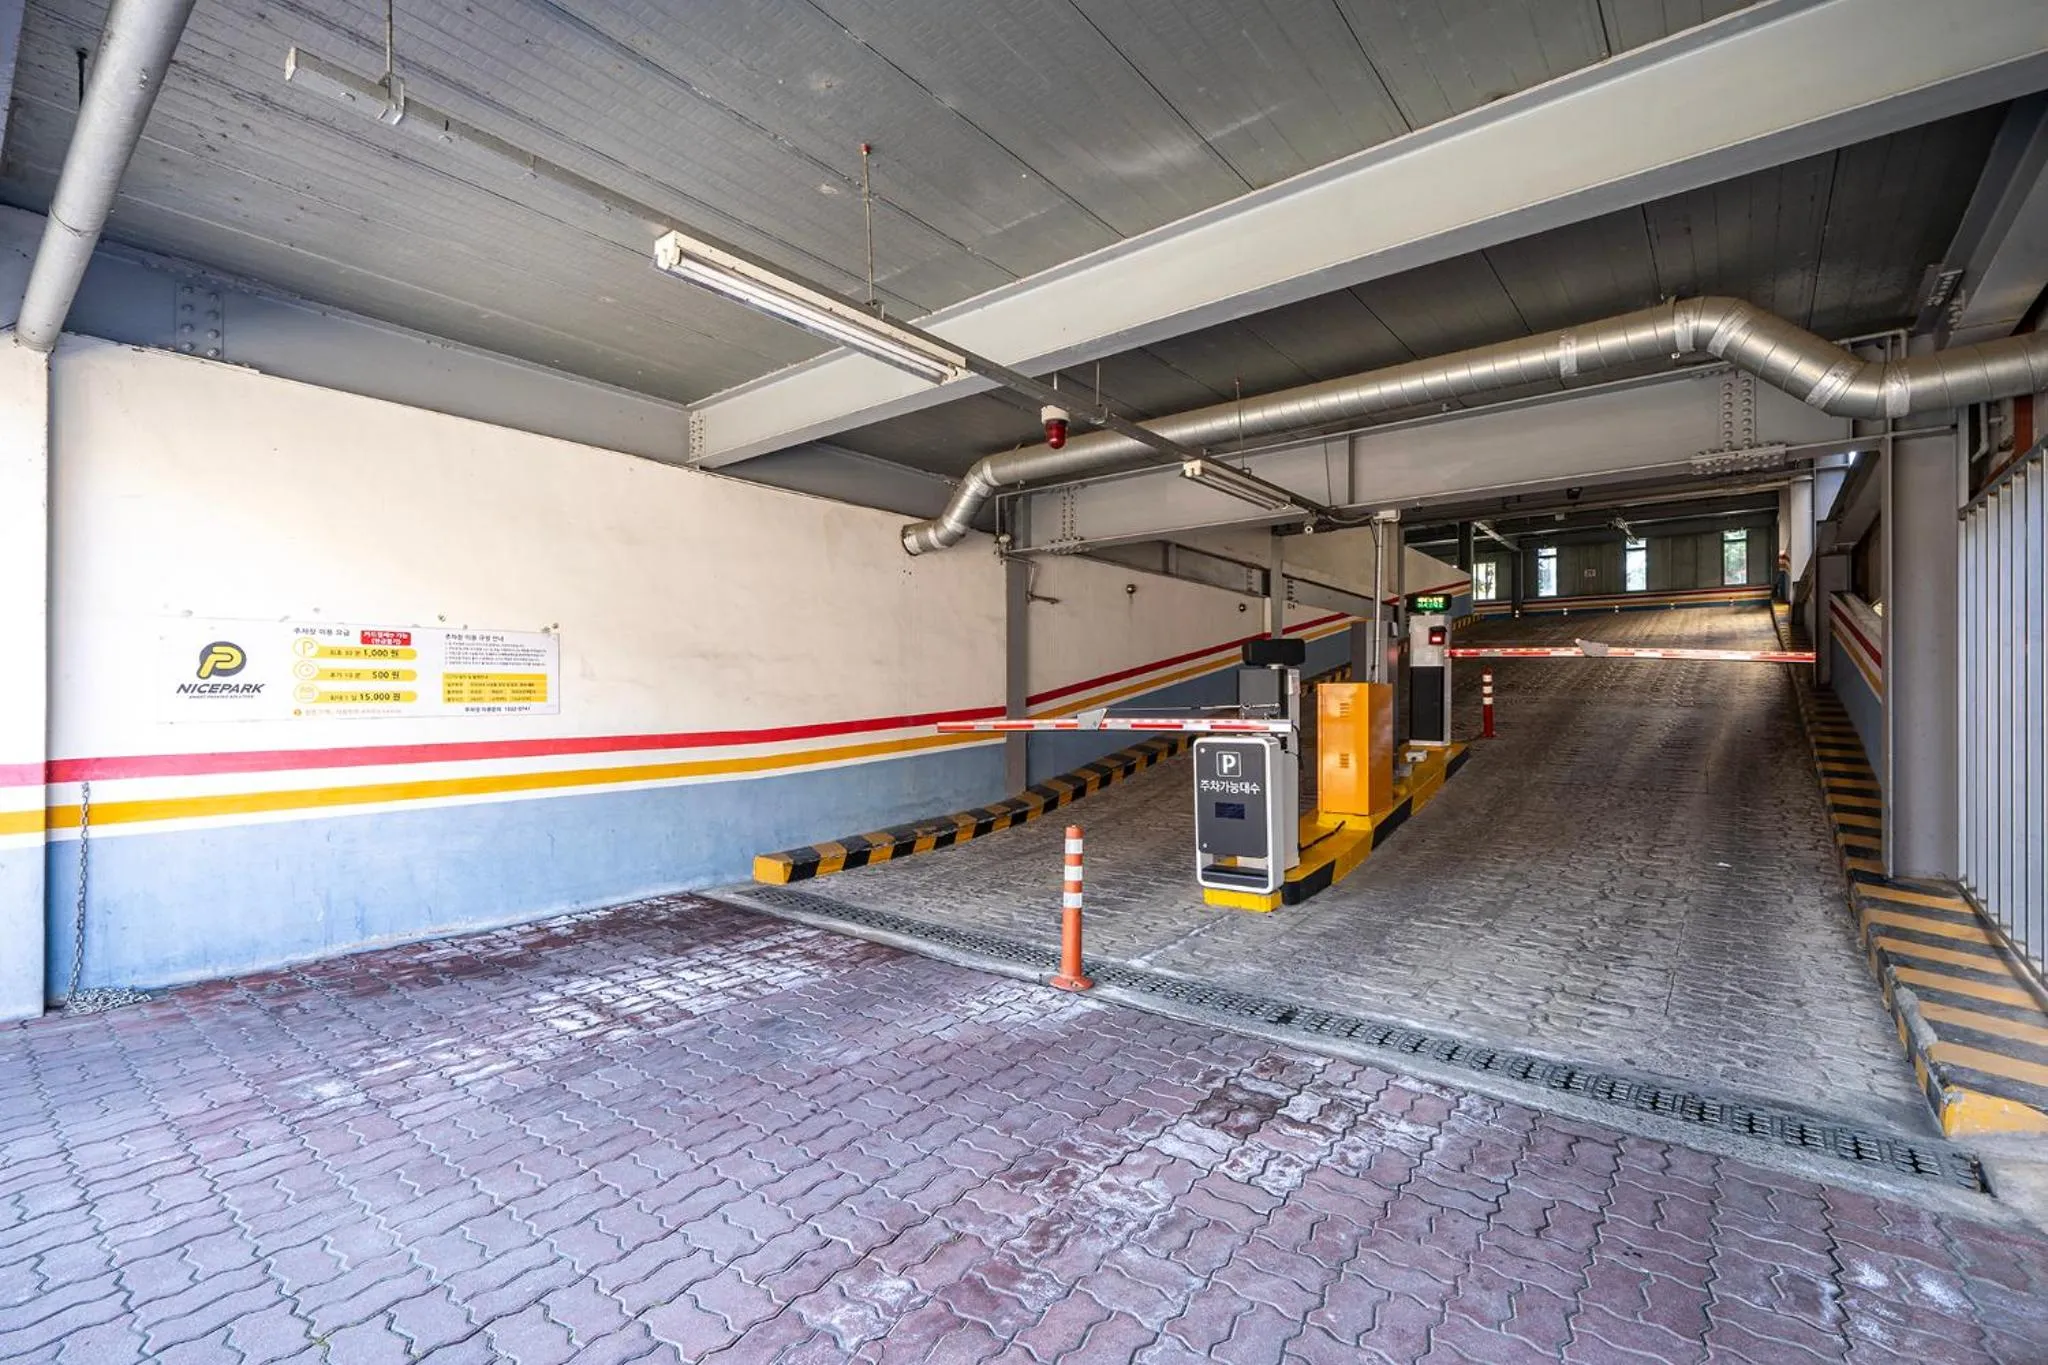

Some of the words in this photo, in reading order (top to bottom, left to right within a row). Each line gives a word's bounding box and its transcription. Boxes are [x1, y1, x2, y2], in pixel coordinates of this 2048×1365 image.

[364, 649, 389, 658] 1,000
[390, 649, 400, 659] 원
[372, 671, 389, 679] 500
[391, 671, 400, 680] 원
[176, 683, 265, 694] NICEPARK
[360, 693, 390, 702] 15,000
[393, 693, 401, 702] 원
[1222, 754, 1236, 774] P
[1200, 780, 1261, 795] 주차가능대수
